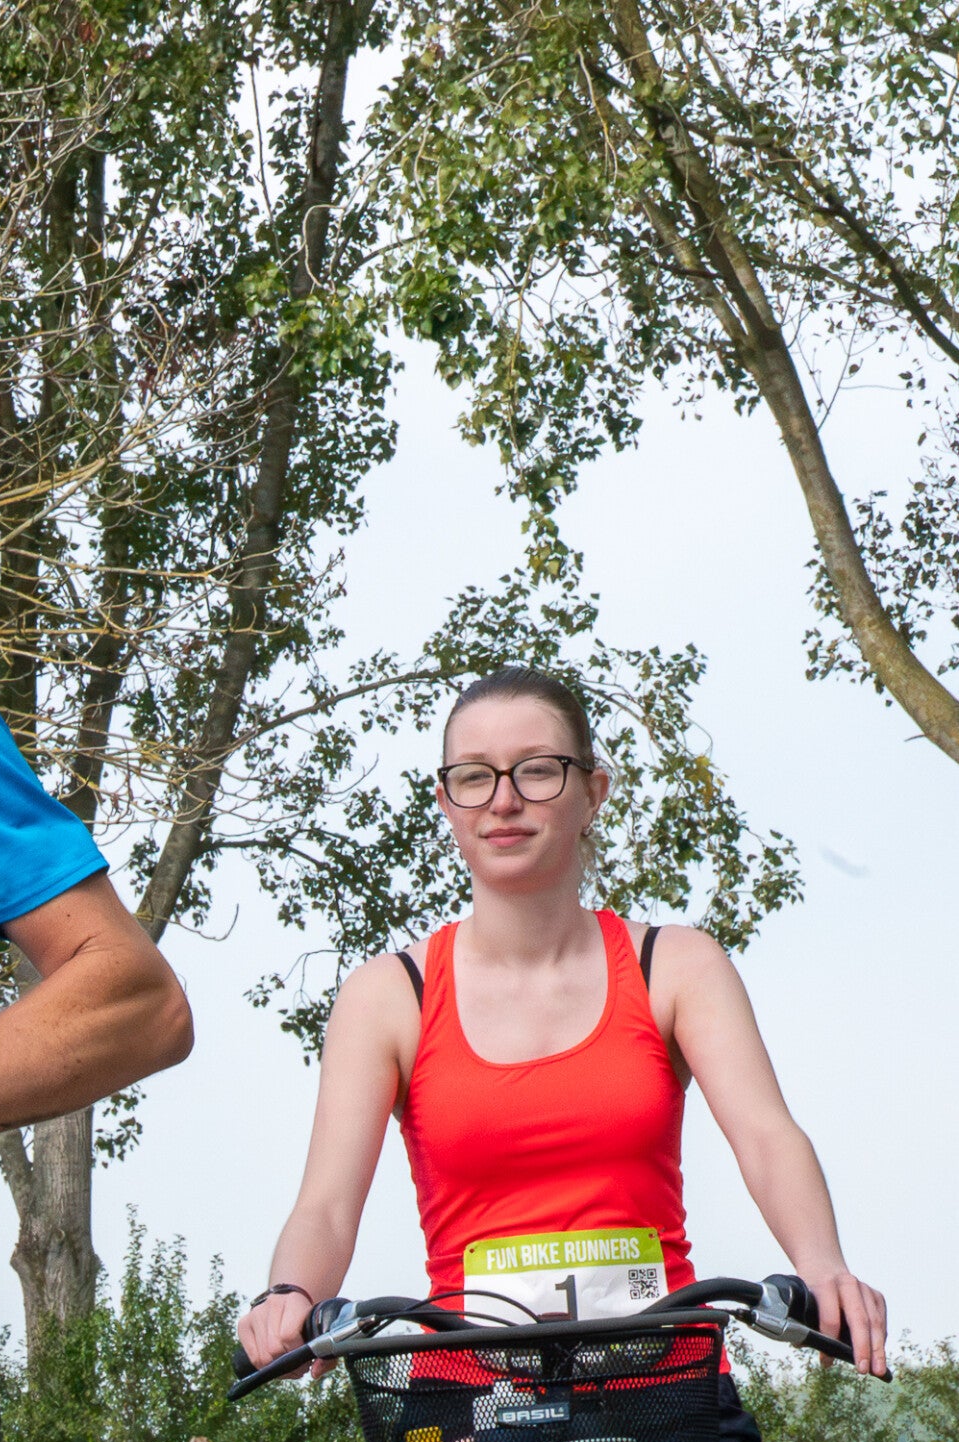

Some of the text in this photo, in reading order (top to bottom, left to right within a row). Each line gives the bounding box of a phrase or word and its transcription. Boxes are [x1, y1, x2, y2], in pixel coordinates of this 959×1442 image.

[486, 1237, 640, 1271] FUN BIKE RUNNERS
[555, 1274, 579, 1321] 1
[502, 1407, 564, 1422] BASIL
